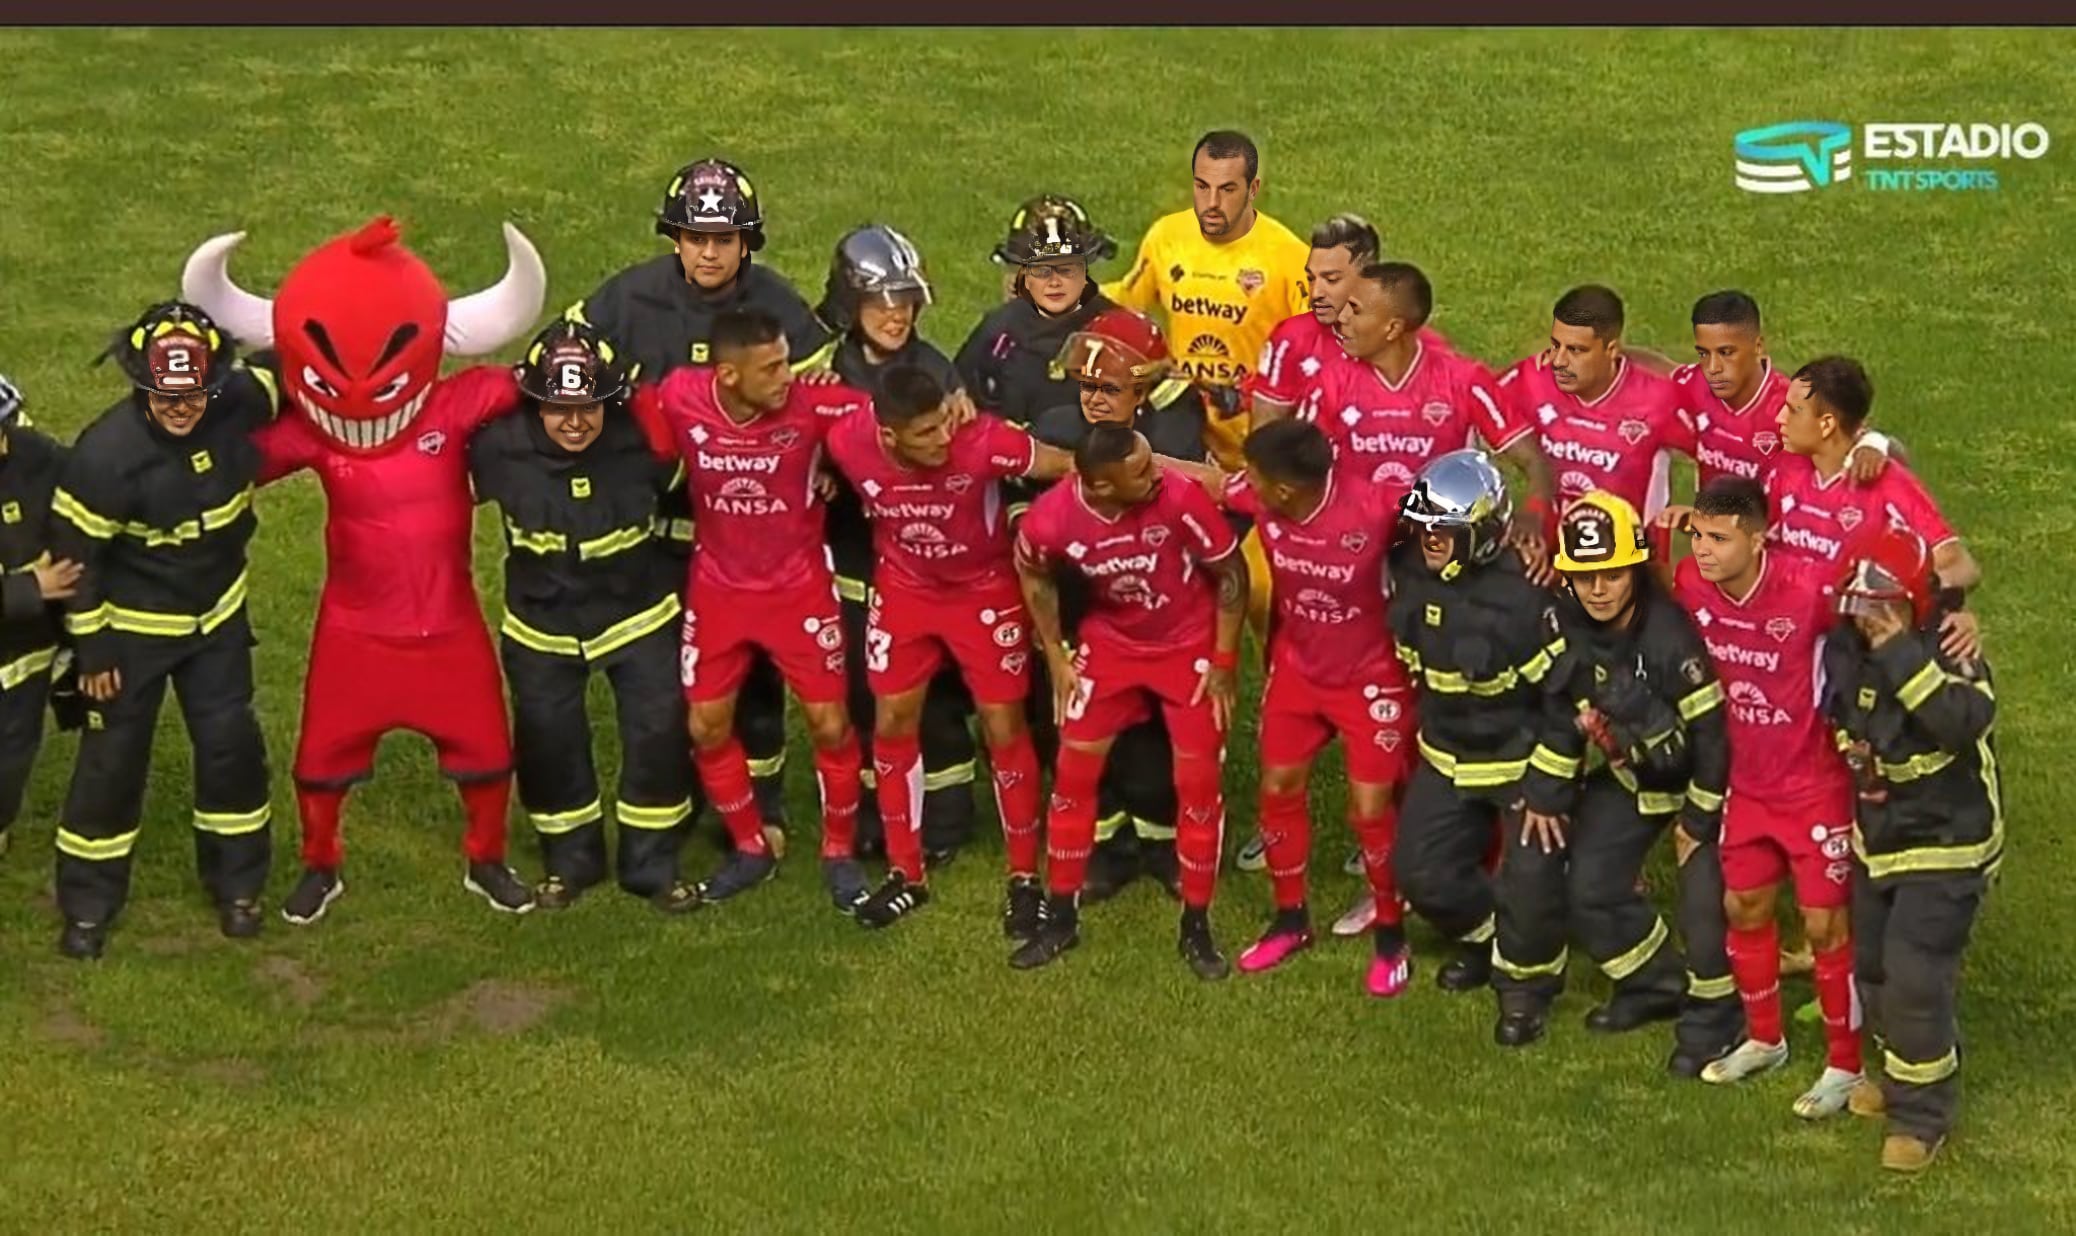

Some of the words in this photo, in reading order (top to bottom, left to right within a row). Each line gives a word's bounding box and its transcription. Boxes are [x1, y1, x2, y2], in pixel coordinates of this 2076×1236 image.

[1044, 218, 1060, 243] 1
[1171, 293, 1248, 325] betway
[167, 349, 190, 372] 2
[1085, 340, 1104, 377] 7
[1174, 359, 1248, 380] ANSA
[562, 363, 582, 389] 6
[1351, 432, 1434, 456] betway
[1541, 433, 1620, 473] betway
[697, 451, 781, 474] betway
[1697, 441, 1759, 479] betway
[704, 494, 788, 515] IANSA
[873, 502, 955, 521] betway
[1577, 520, 1600, 547] 3
[1782, 521, 1841, 562] betway
[1081, 553, 1158, 577] betway
[1273, 549, 1355, 584] betway
[1704, 636, 1780, 673] betway
